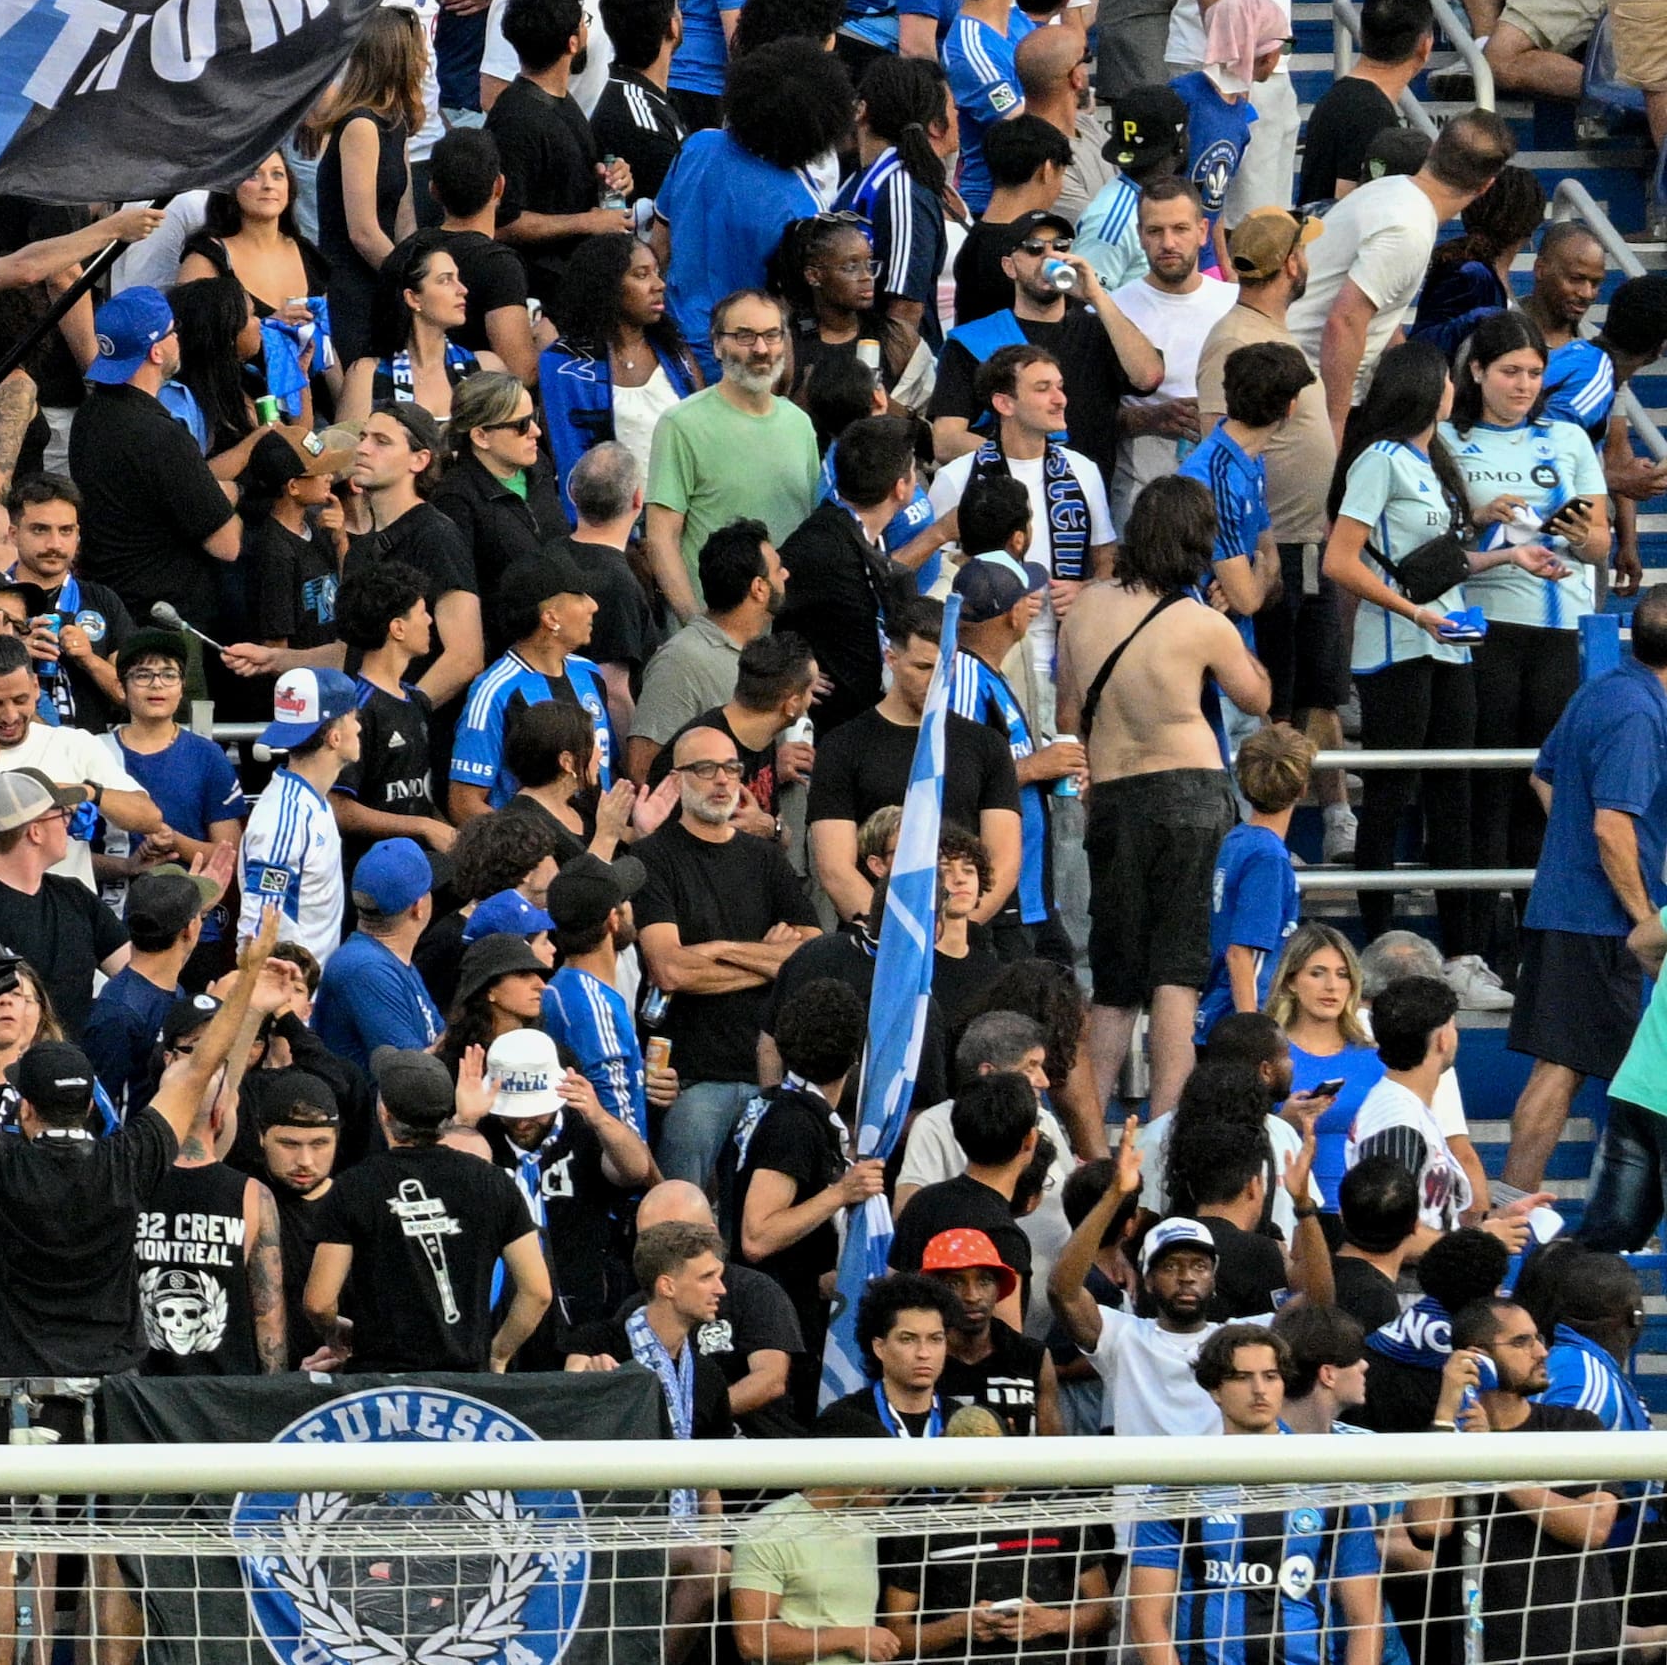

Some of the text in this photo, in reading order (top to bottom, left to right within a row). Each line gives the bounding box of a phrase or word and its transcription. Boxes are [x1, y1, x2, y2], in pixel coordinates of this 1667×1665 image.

[1123, 121, 1137, 142] P
[1468, 471, 1522, 484] BMO
[450, 758, 494, 776] TELUS
[175, 1213, 246, 1242] CREW
[301, 1394, 520, 1443] EUNESS
[1204, 1560, 1273, 1584] BMO
